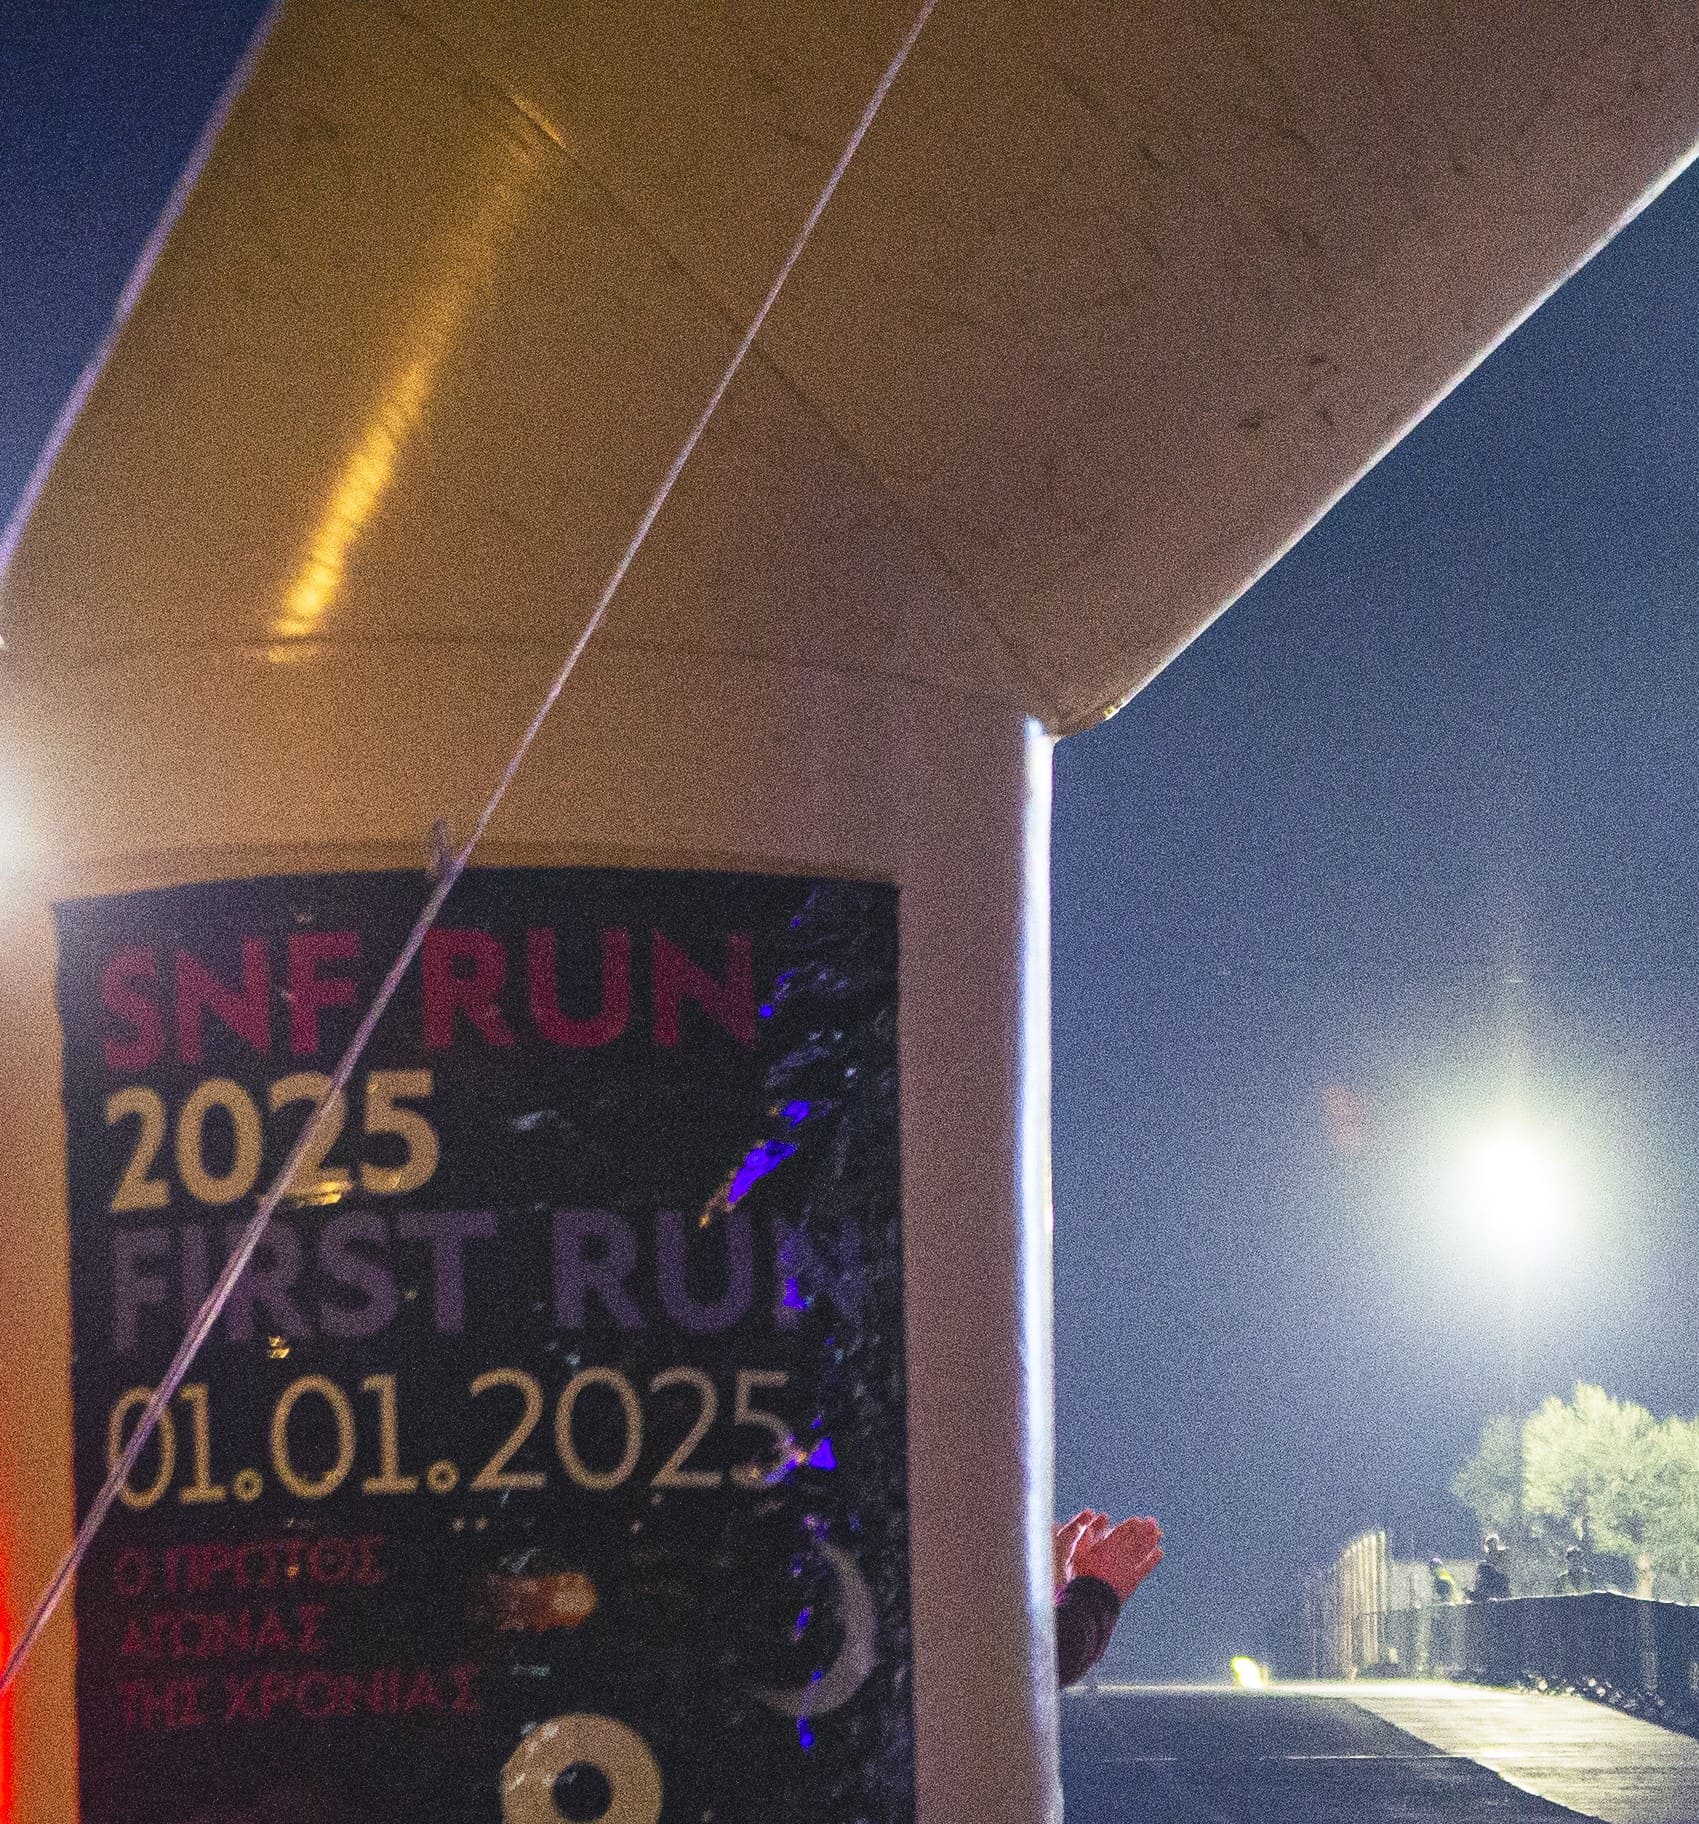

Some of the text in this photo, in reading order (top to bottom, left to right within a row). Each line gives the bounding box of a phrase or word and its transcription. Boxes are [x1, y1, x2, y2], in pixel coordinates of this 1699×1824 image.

[101, 928, 760, 1071] SNF RUN
[104, 1068, 441, 1213] 2025
[111, 1204, 863, 1354] FIRST RUN
[105, 1364, 797, 1509] 01.01.2025
